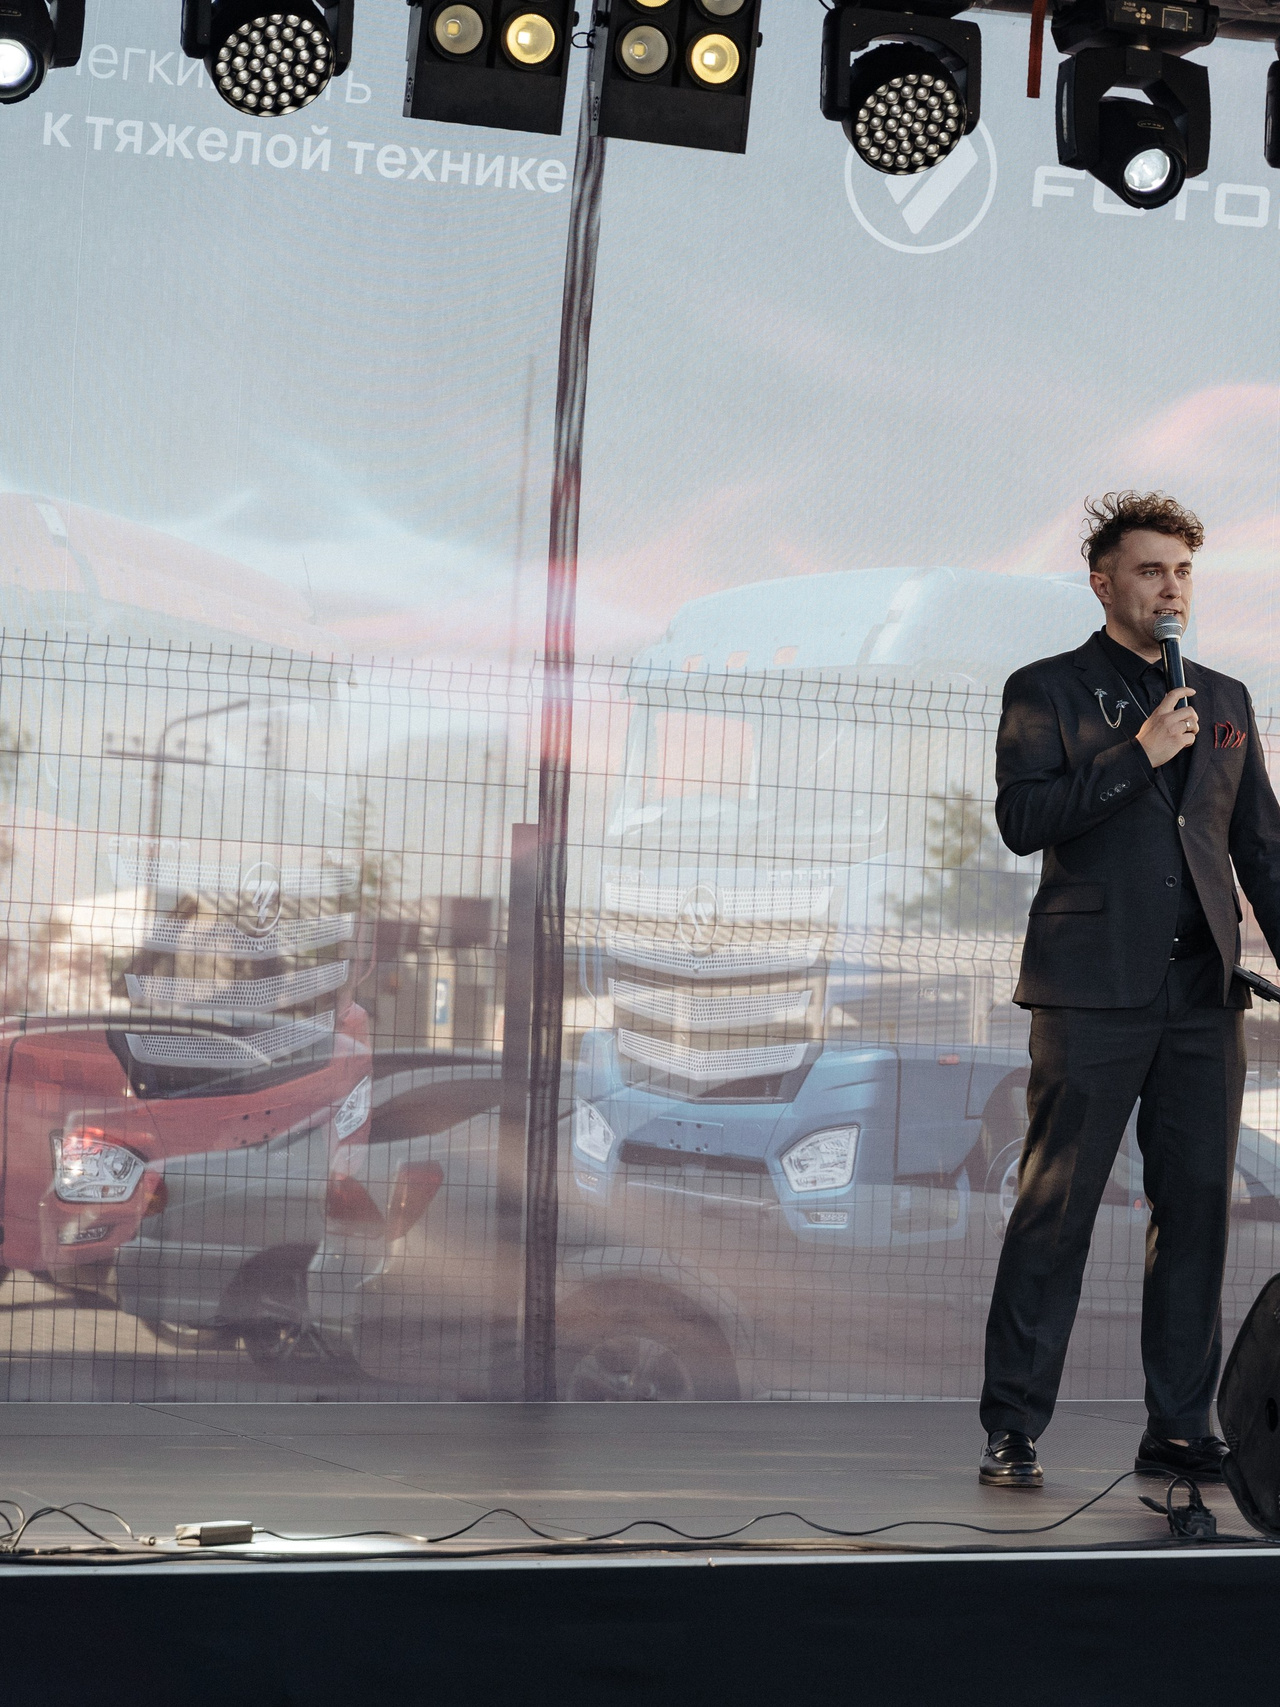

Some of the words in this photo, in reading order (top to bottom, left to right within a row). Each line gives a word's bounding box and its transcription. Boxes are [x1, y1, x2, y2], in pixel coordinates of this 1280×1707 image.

[75, 43, 216, 90] егки
[43, 111, 73, 148] к
[85, 115, 331, 172] тяжелой
[347, 140, 567, 193] технике
